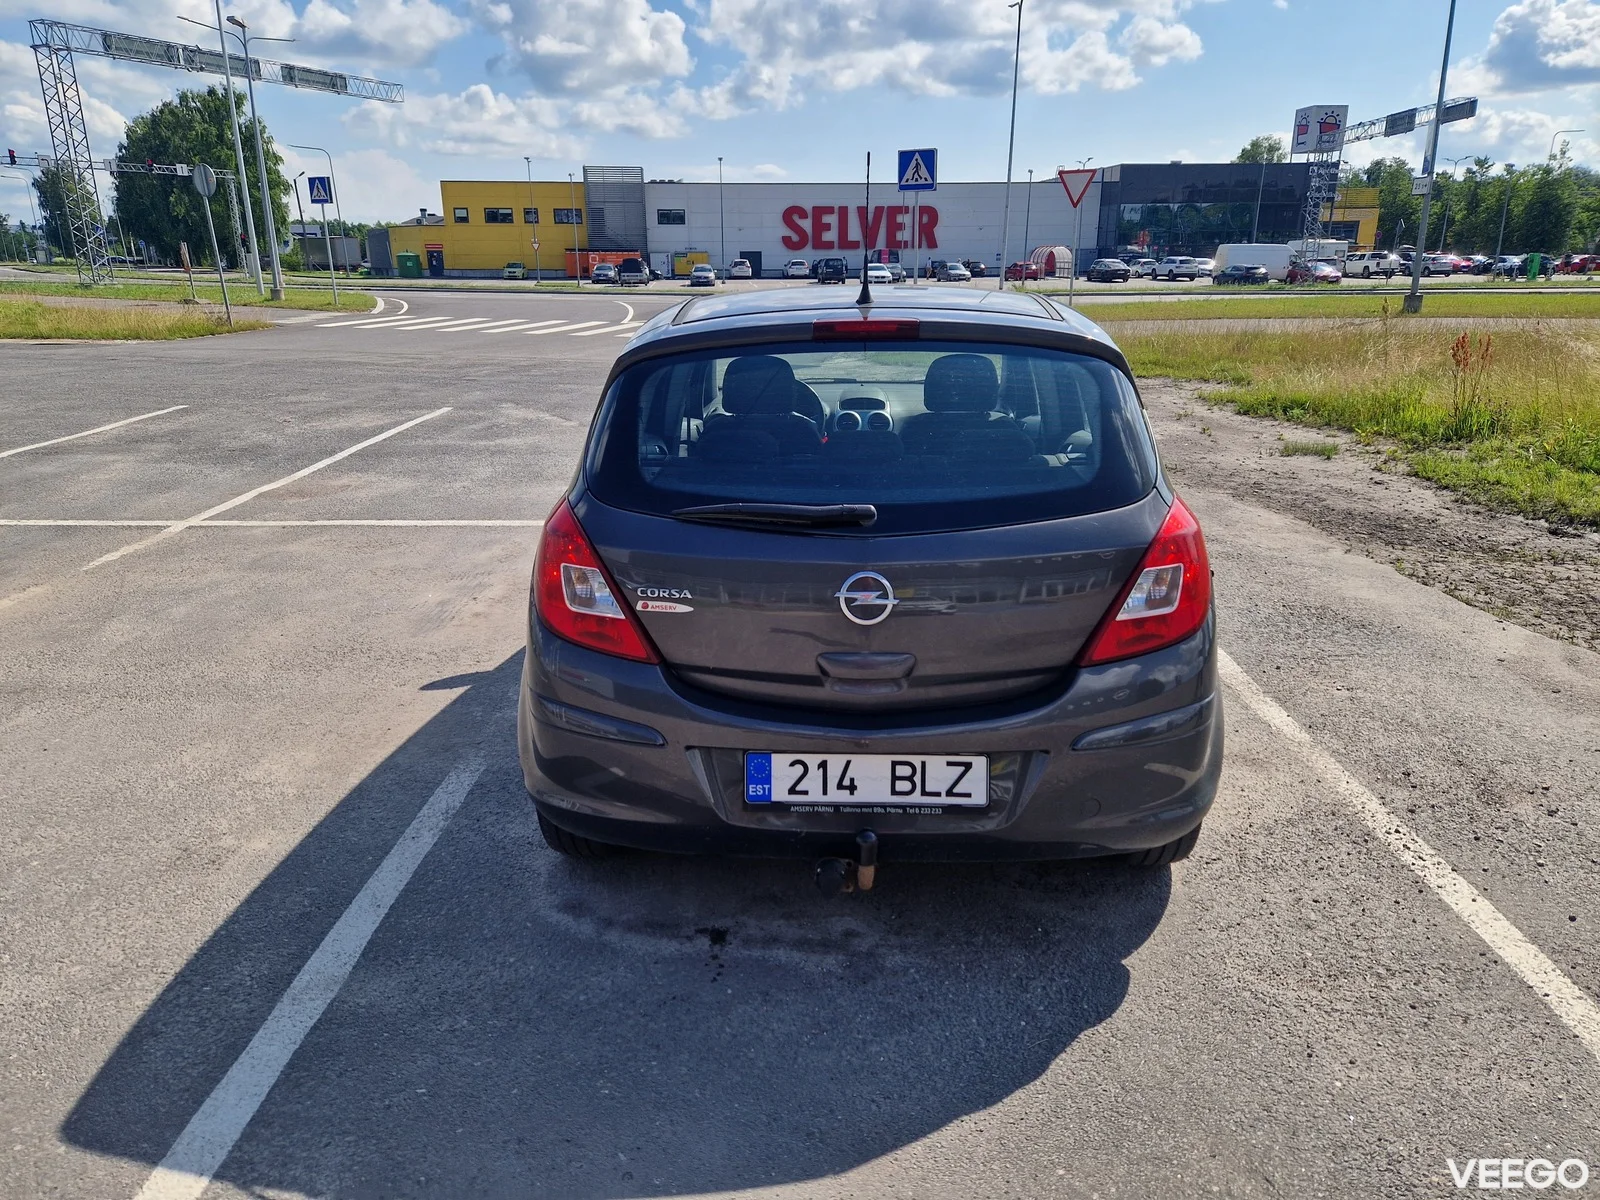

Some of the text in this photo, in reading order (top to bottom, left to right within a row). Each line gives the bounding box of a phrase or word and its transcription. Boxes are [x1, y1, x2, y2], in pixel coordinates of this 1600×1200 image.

[781, 205, 939, 251] SELVER
[637, 587, 693, 599] CORSA
[749, 784, 770, 796] EST
[787, 759, 973, 798] 214 BLZ
